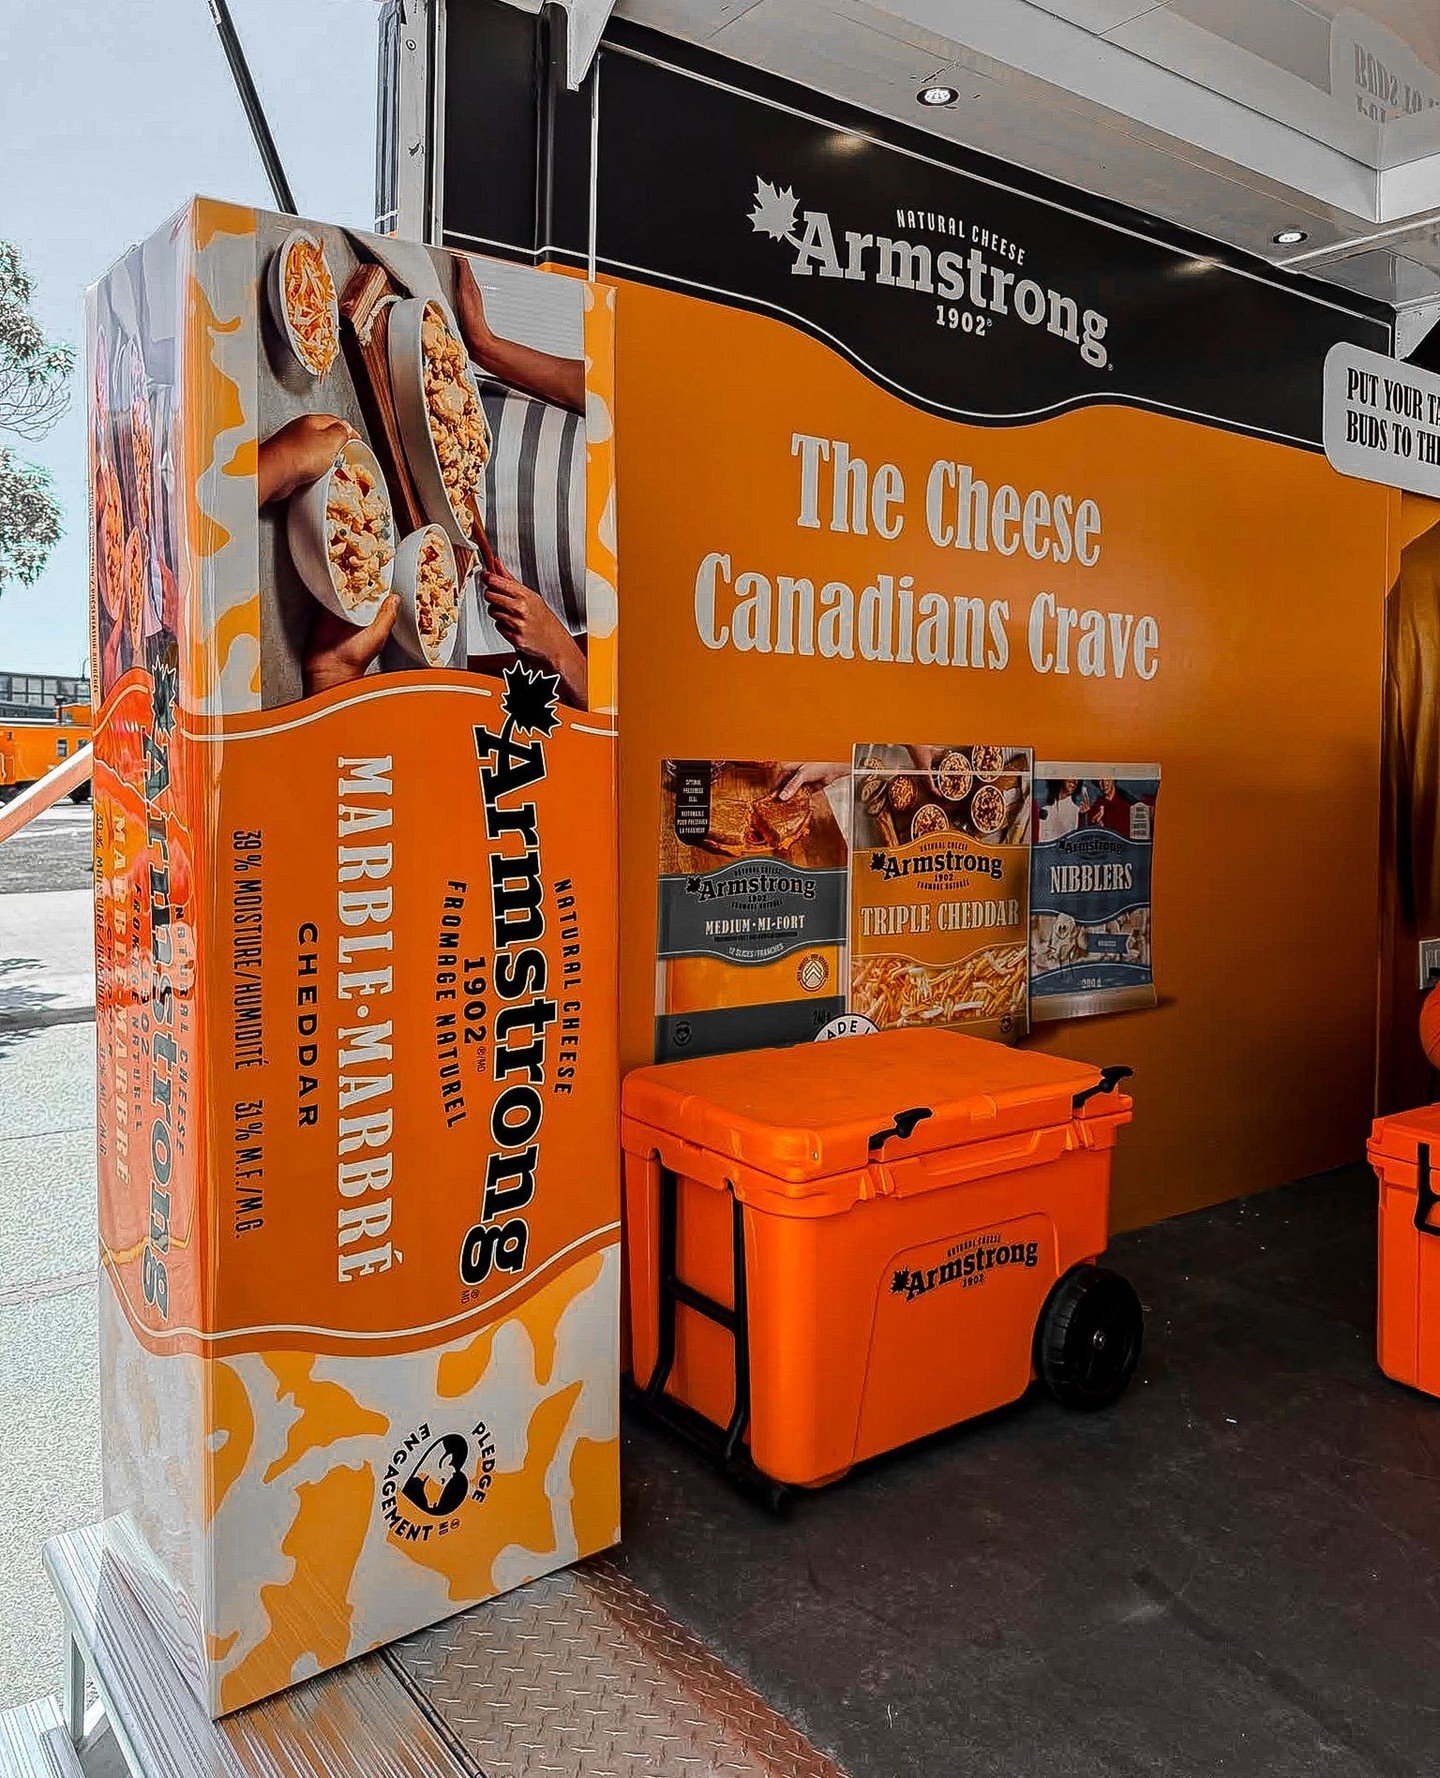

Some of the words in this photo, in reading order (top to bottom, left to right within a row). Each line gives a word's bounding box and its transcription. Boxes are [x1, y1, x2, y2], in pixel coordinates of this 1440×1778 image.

[896, 209, 965, 238] NATURAL
[971, 225, 1025, 266] CHEESE
[790, 210, 1109, 368] Armstrong
[1346, 366, 1379, 407] PUT
[1383, 378, 1423, 421] YOUR
[1346, 409, 1388, 451] BUDS
[1392, 422, 1412, 457] TO
[791, 433, 905, 540] The
[926, 460, 1102, 567] Cheese
[694, 552, 1011, 670] Canadians
[1028, 592, 1160, 680] Crave
[699, 873, 816, 902] Armstrong
[884, 850, 1003, 881] Armstrong
[1050, 862, 1133, 894] NIBBLERS
[435, 880, 467, 1001] FROMAGE
[553, 878, 582, 990] NATURAL
[861, 904, 931, 937] TRIPLE
[937, 899, 1020, 932] CHEDDAR
[143, 725, 178, 1322] Armstrong
[297, 922, 319, 1128] CHEDDAR
[459, 724, 558, 1287] Armstrong
[553, 1001, 582, 1095] CHEESE
[826, 1019, 858, 1040] ADE
[434, 1013, 467, 1129] NATUREL
[906, 1241, 1039, 1302] Armstrong
[381, 1422, 434, 1541] ENGAGEMENT
[471, 1421, 496, 1503] PLEDGE
